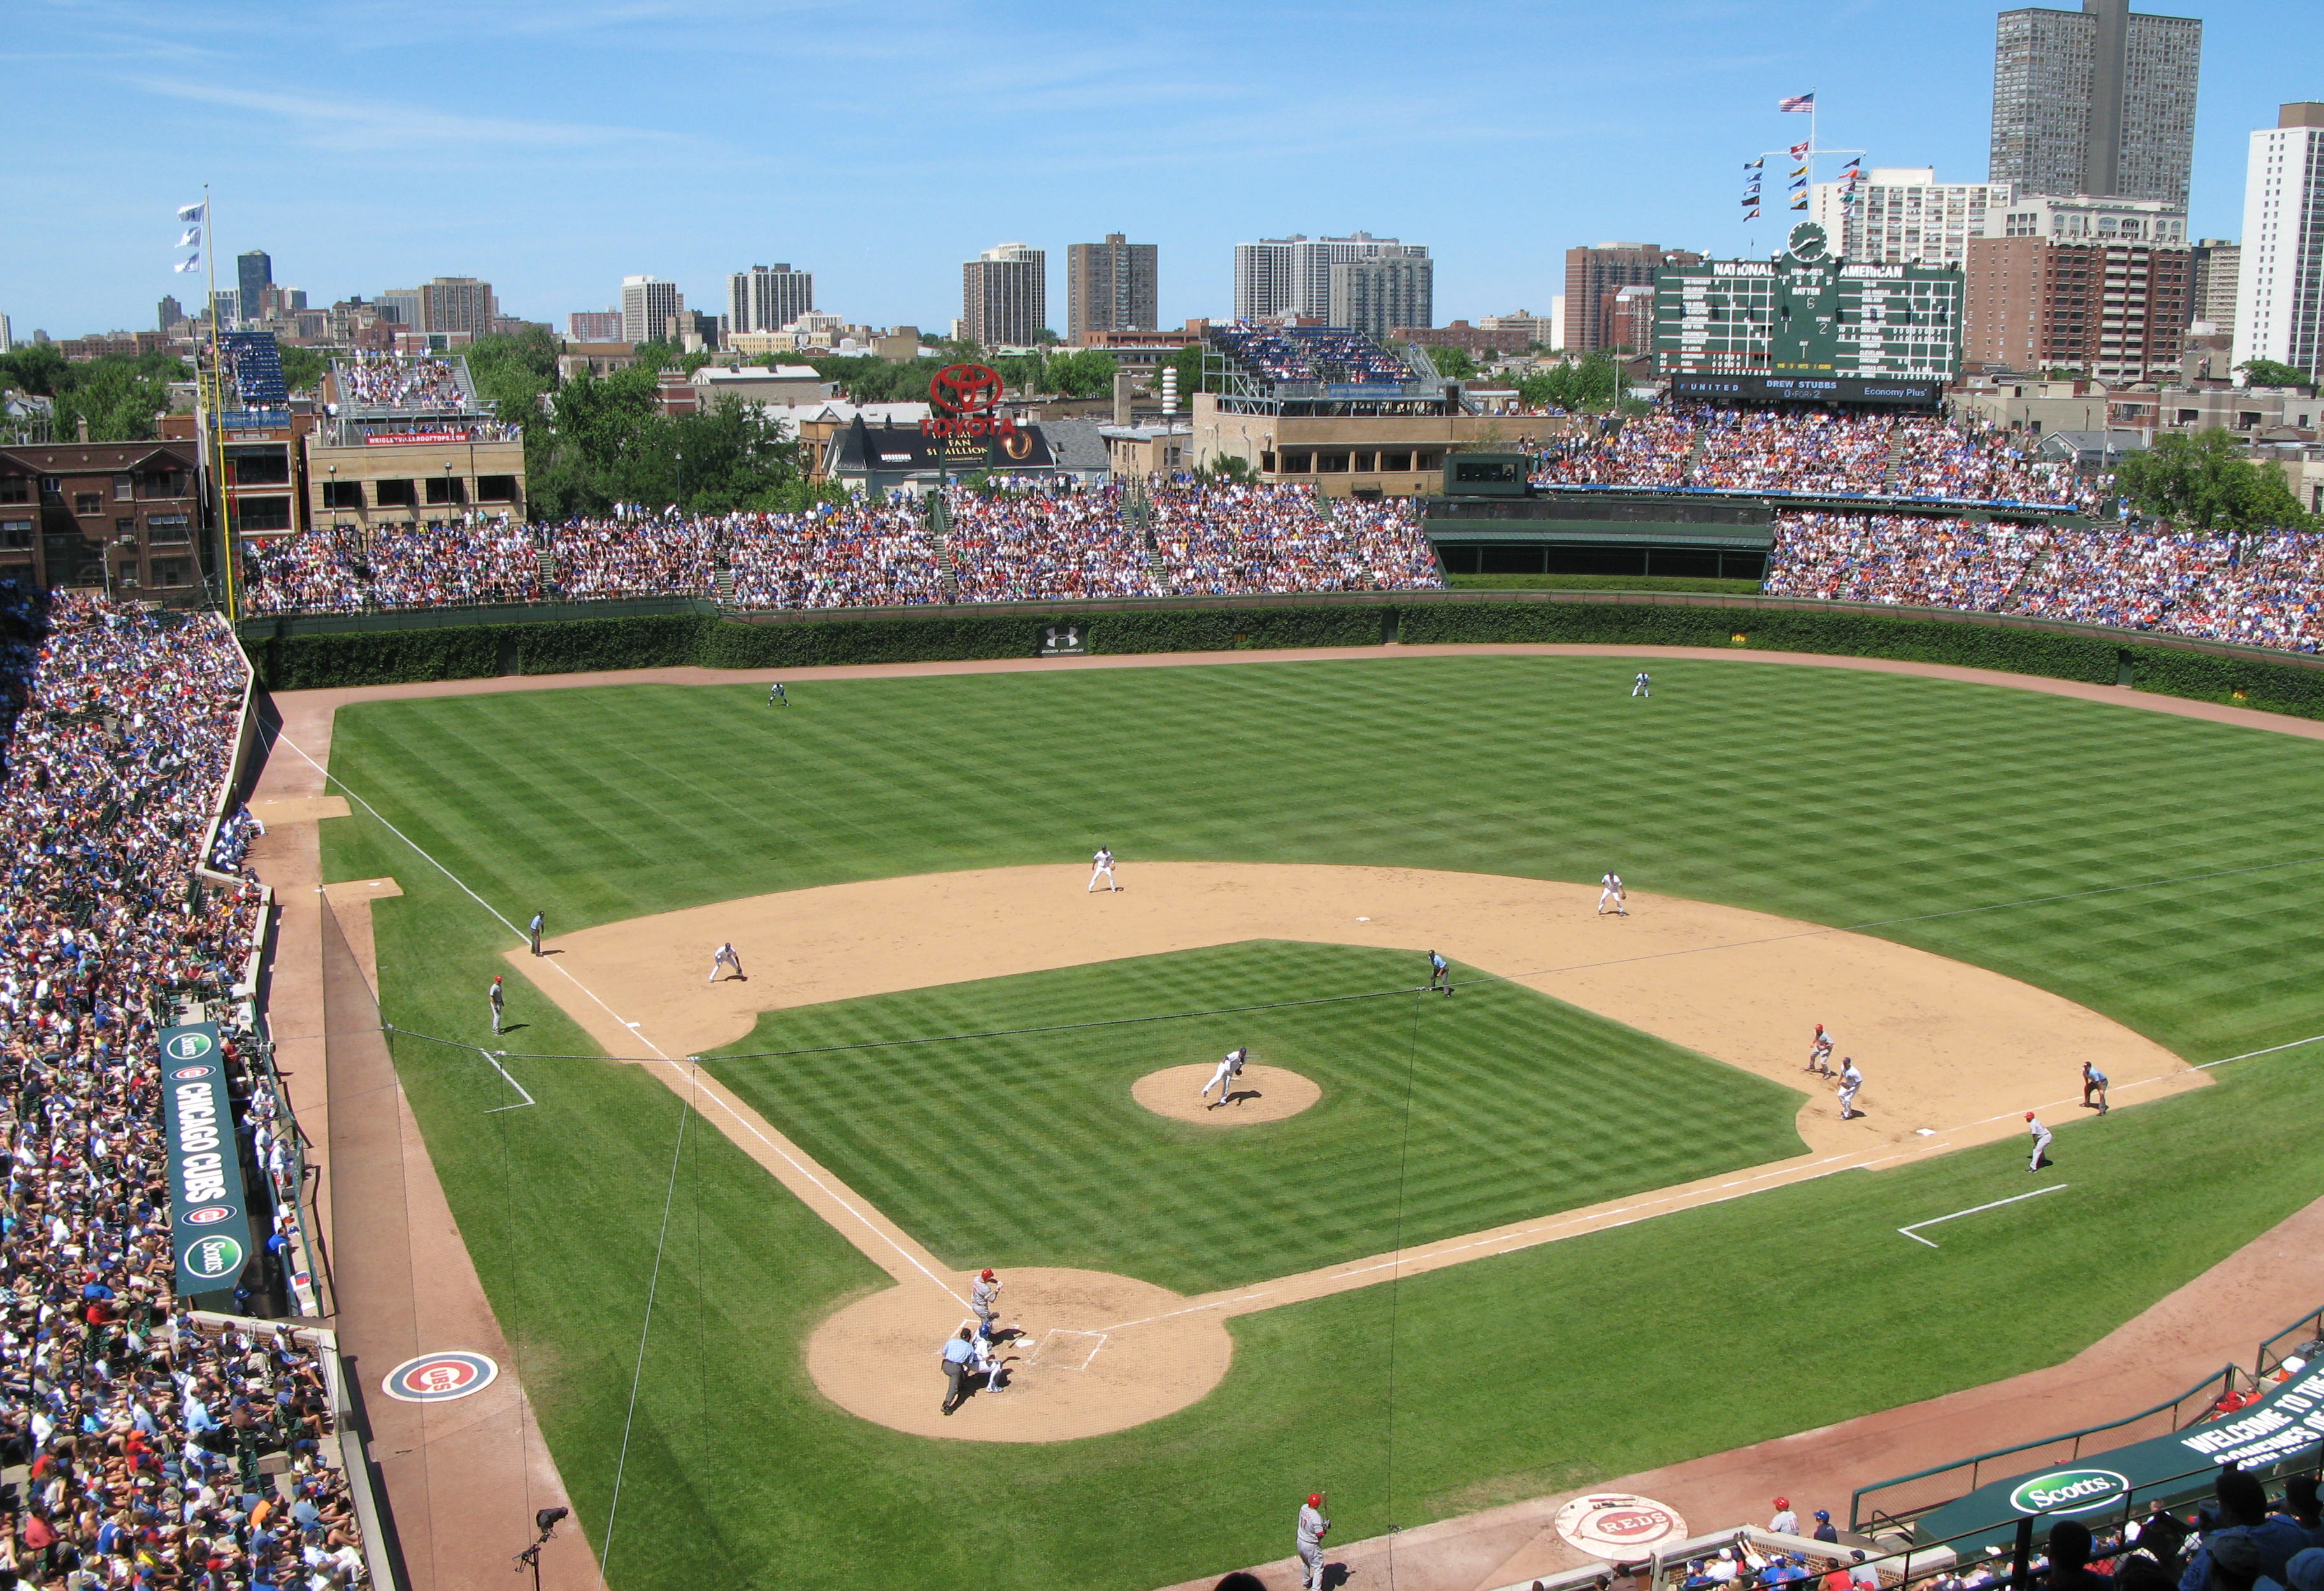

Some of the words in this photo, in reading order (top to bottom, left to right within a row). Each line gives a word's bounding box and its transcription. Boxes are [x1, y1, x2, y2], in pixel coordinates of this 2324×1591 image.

[1714, 263, 1775, 276] NATIONAL
[1839, 266, 1903, 278] AMERICAN
[1791, 287, 1821, 296] BATTER
[1819, 322, 1828, 334] 2
[1766, 380, 1794, 389] DREW
[1798, 381, 1837, 389] STUBBS
[1864, 387, 1904, 397] Economy
[918, 418, 1017, 438] TOYOTA
[176, 1082, 220, 1152] CHICAGO
[182, 1152, 227, 1203] CUBS
[2180, 1408, 2293, 1454] WELCOME
[2273, 1394, 2314, 1414] TO
[1600, 1512, 1668, 1533] REDS
